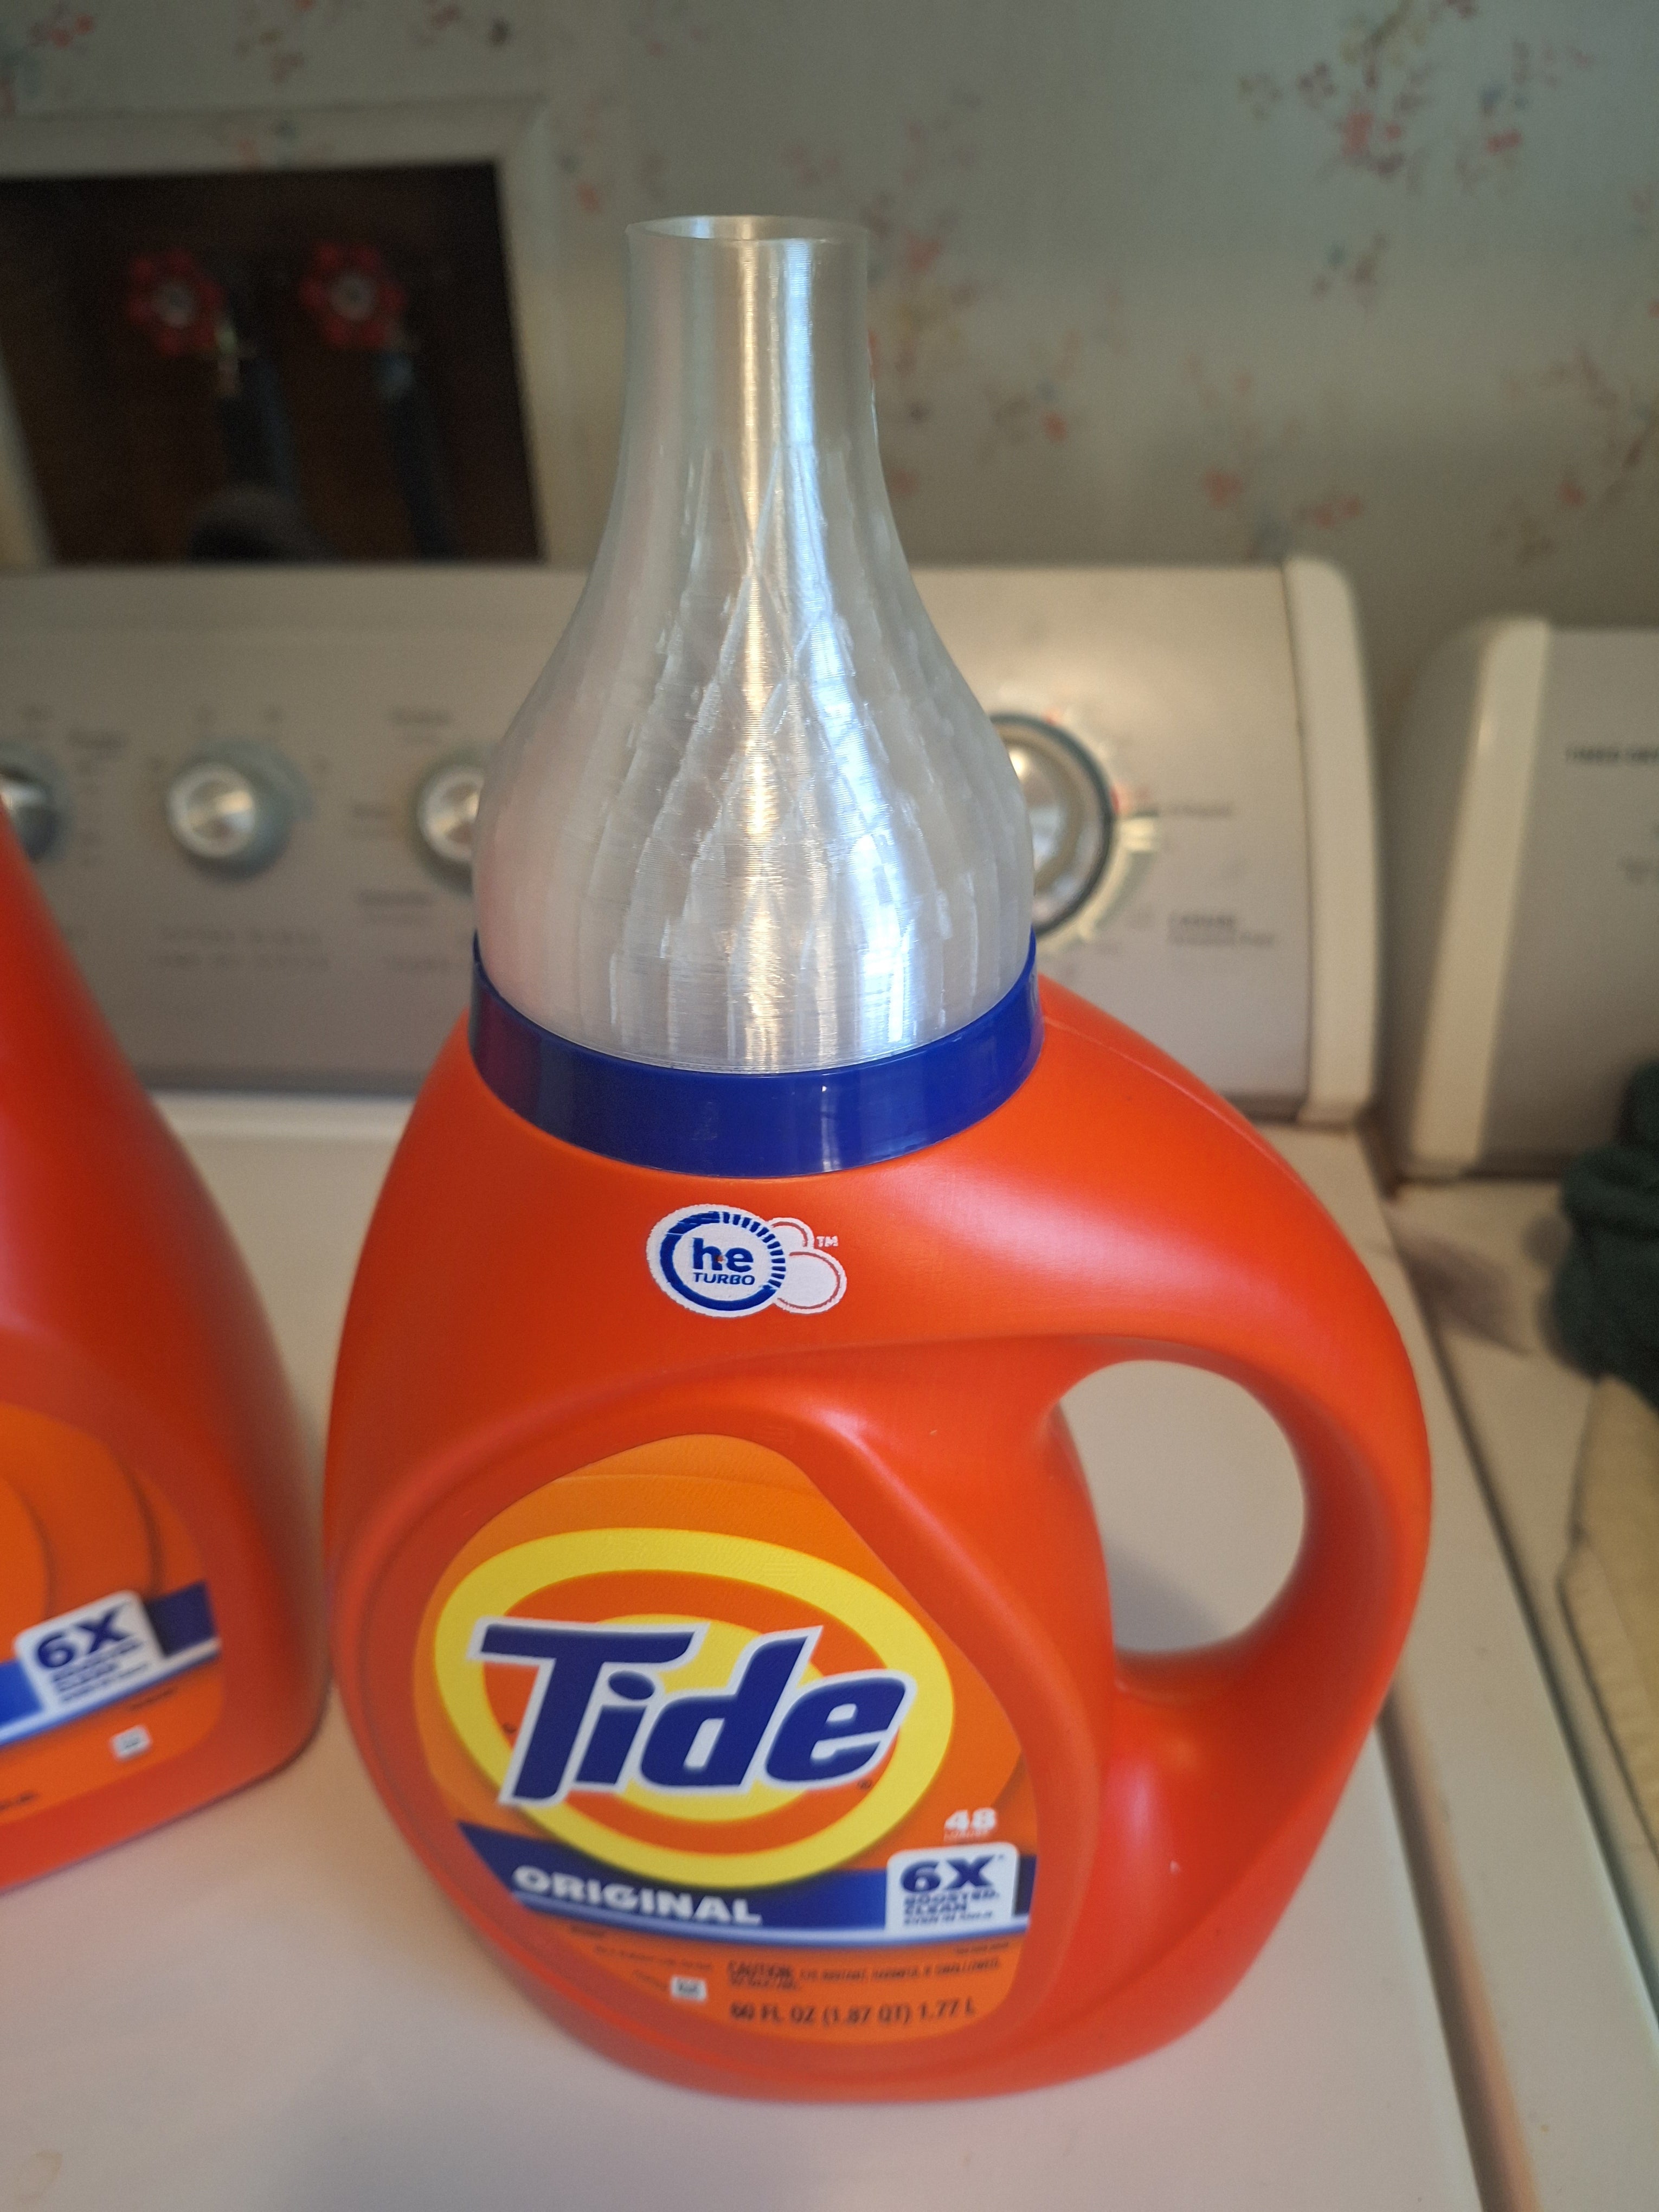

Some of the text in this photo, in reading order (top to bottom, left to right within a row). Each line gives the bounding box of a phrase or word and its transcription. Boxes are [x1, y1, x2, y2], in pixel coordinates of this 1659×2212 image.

[692, 1237, 754, 1273] he
[693, 1272, 755, 1285] TURBO
[36, 1602, 133, 1670] 6X
[477, 1620, 910, 1804] Tide
[944, 1808, 996, 1831] 48
[512, 1865, 762, 1925] ORIGINAL
[761, 2004, 781, 2022] FL
[790, 2006, 815, 2023] OZ
[921, 1997, 959, 2019] 1.77
[964, 1995, 975, 2015] L
